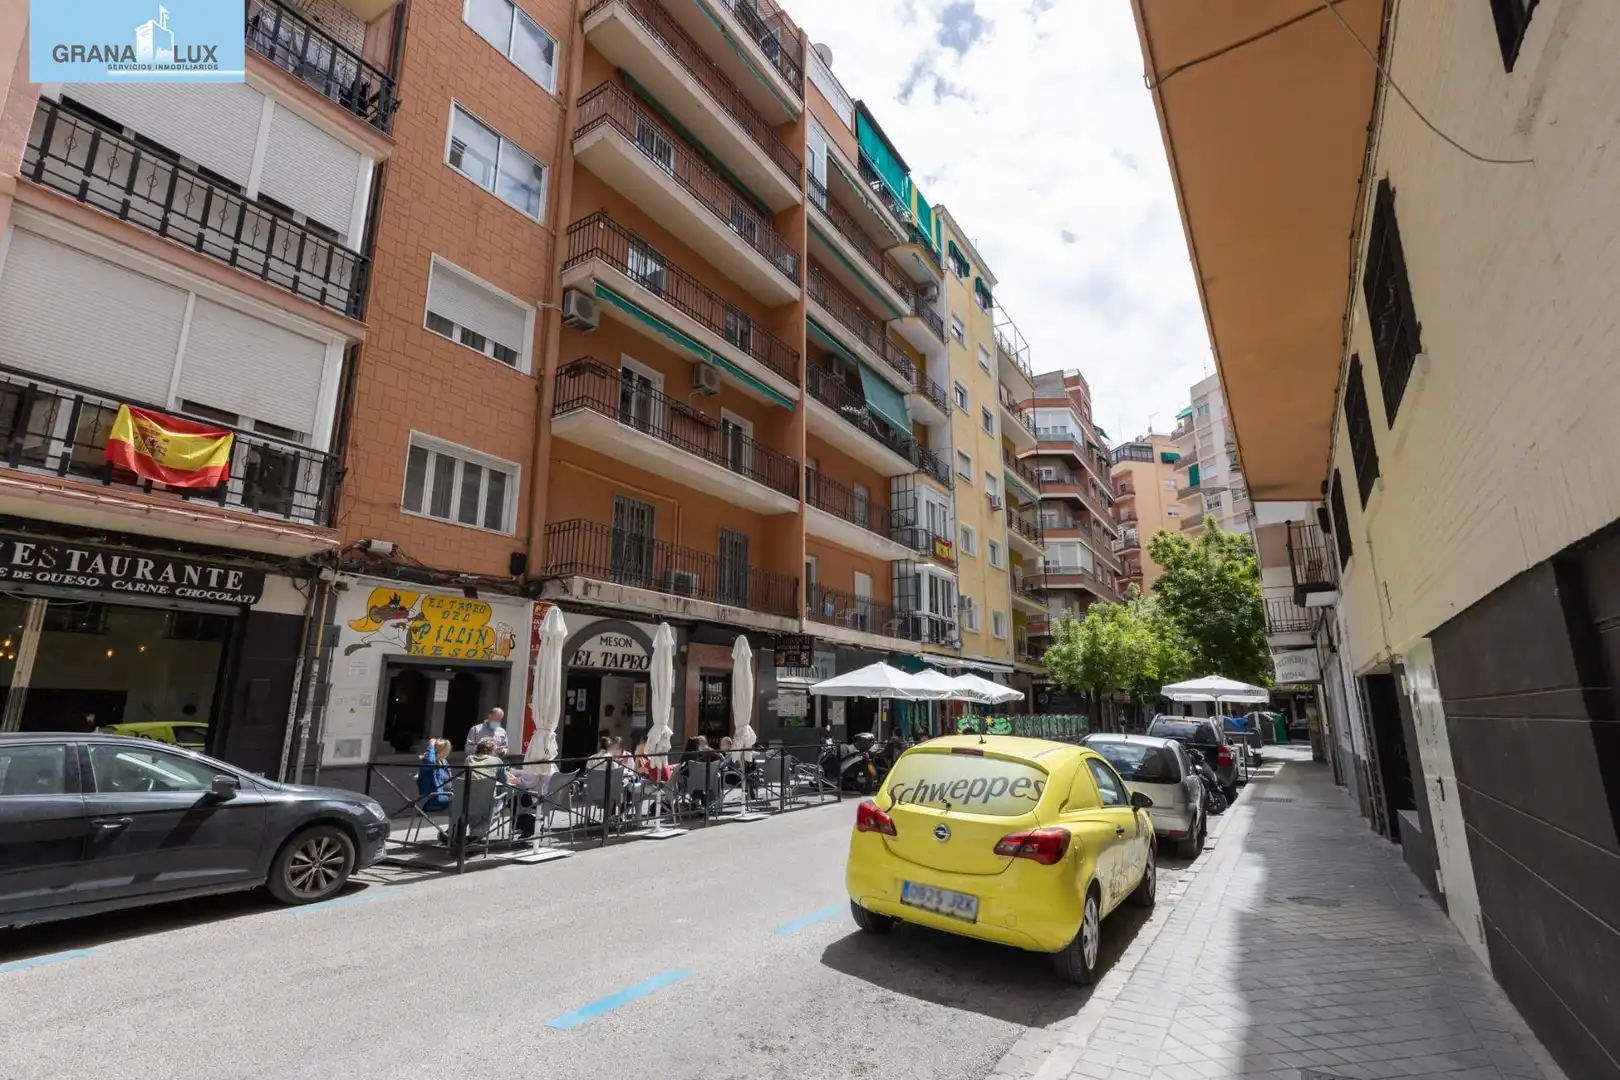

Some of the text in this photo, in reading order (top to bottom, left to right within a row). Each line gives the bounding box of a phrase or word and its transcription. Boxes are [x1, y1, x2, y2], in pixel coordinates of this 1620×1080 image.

[0, 541, 244, 591] ESTAURANTE
[12, 570, 33, 580] DE
[428, 598, 444, 609] EL
[441, 610, 471, 622] DEL
[600, 636, 633, 648] MESON
[573, 650, 650, 670] EL TAPEO
[883, 776, 1047, 814] Schweppes
